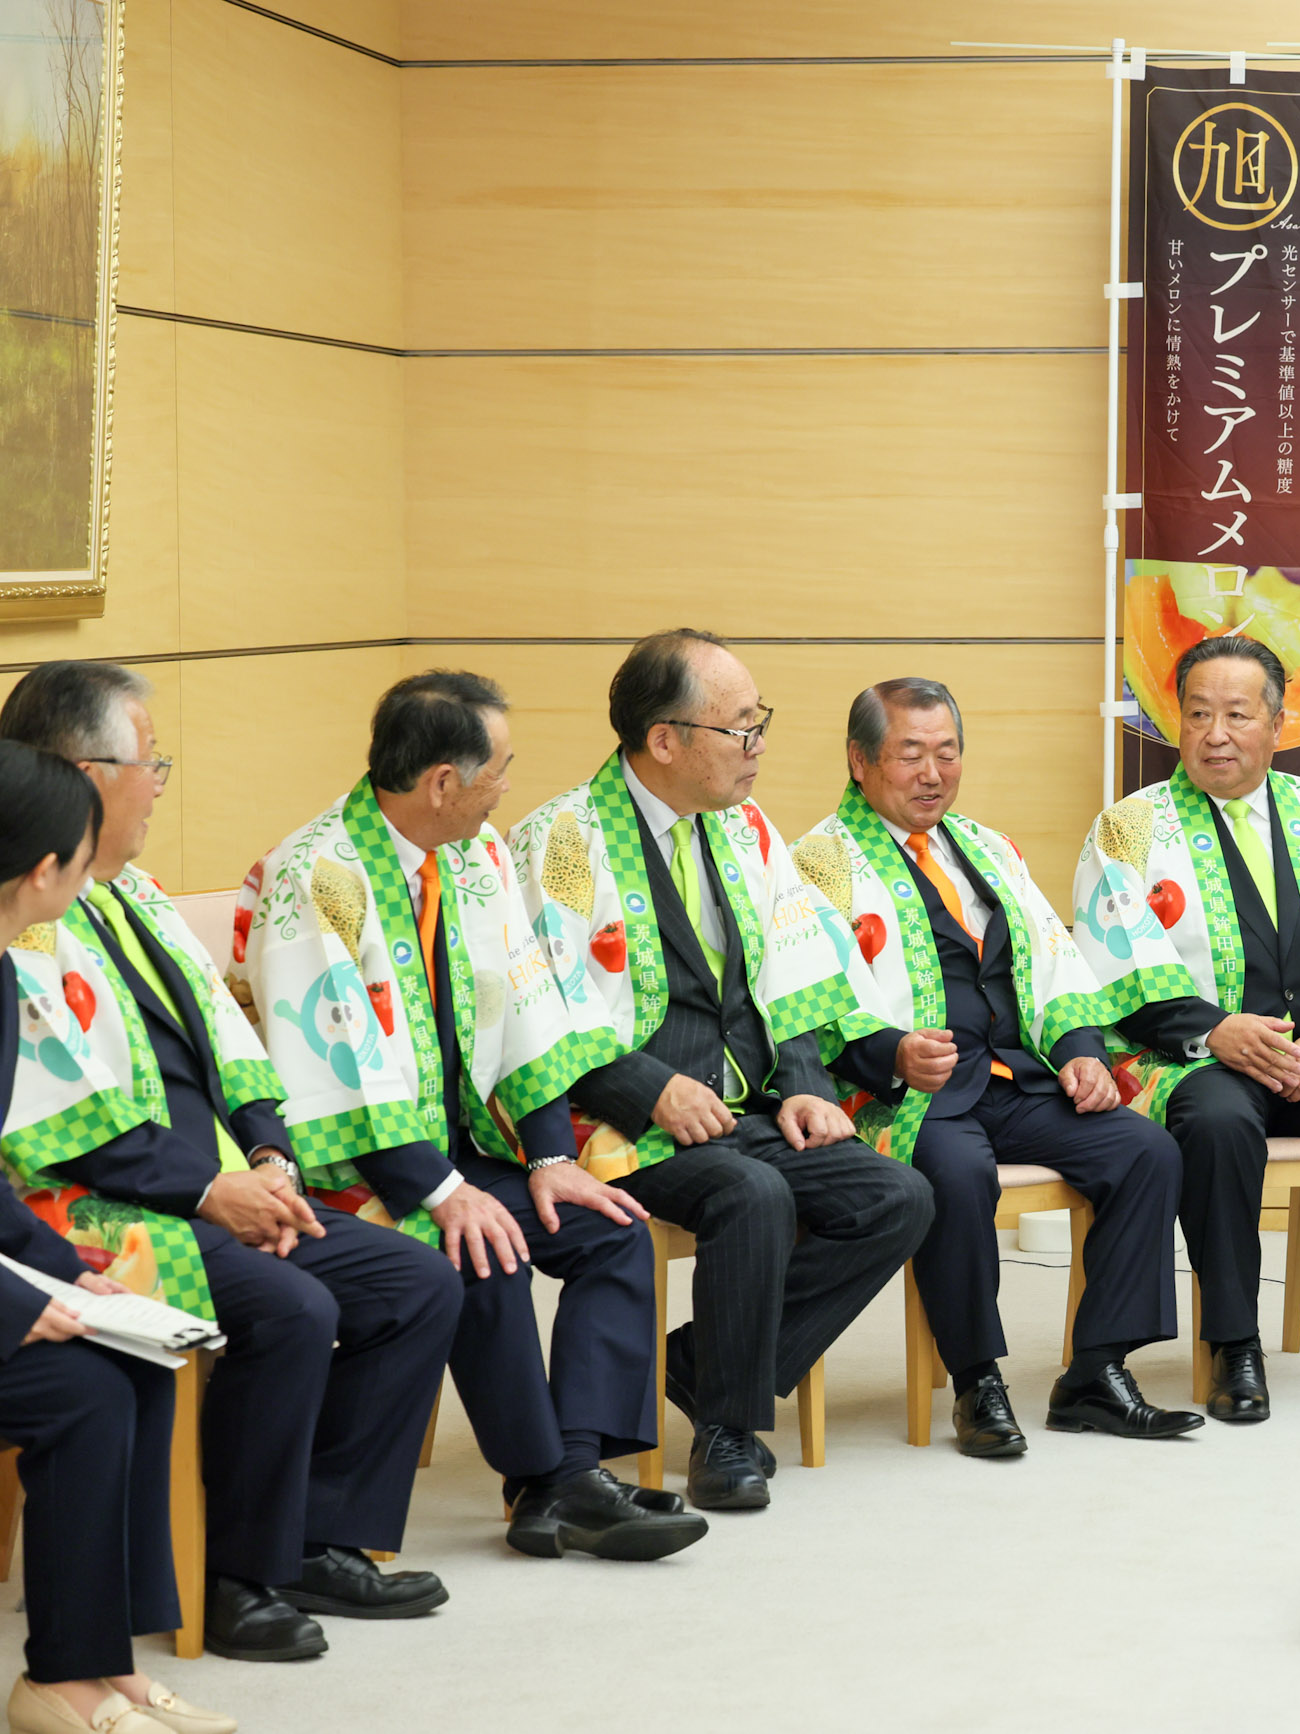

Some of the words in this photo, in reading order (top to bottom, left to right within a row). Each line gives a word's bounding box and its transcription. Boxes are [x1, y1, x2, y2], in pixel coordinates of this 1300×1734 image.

[1183, 121, 1278, 214] 旭
[1166, 239, 1185, 442] 甘いメロンに情熱をかけて
[1275, 244, 1298, 494] 光センサーで基準値以上の糖度
[903, 907, 938, 1026] 茨城県鉾田市
[1200, 859, 1237, 974] 茨城県鉾田市
[401, 975, 438, 1122] 茨城県鉾田市
